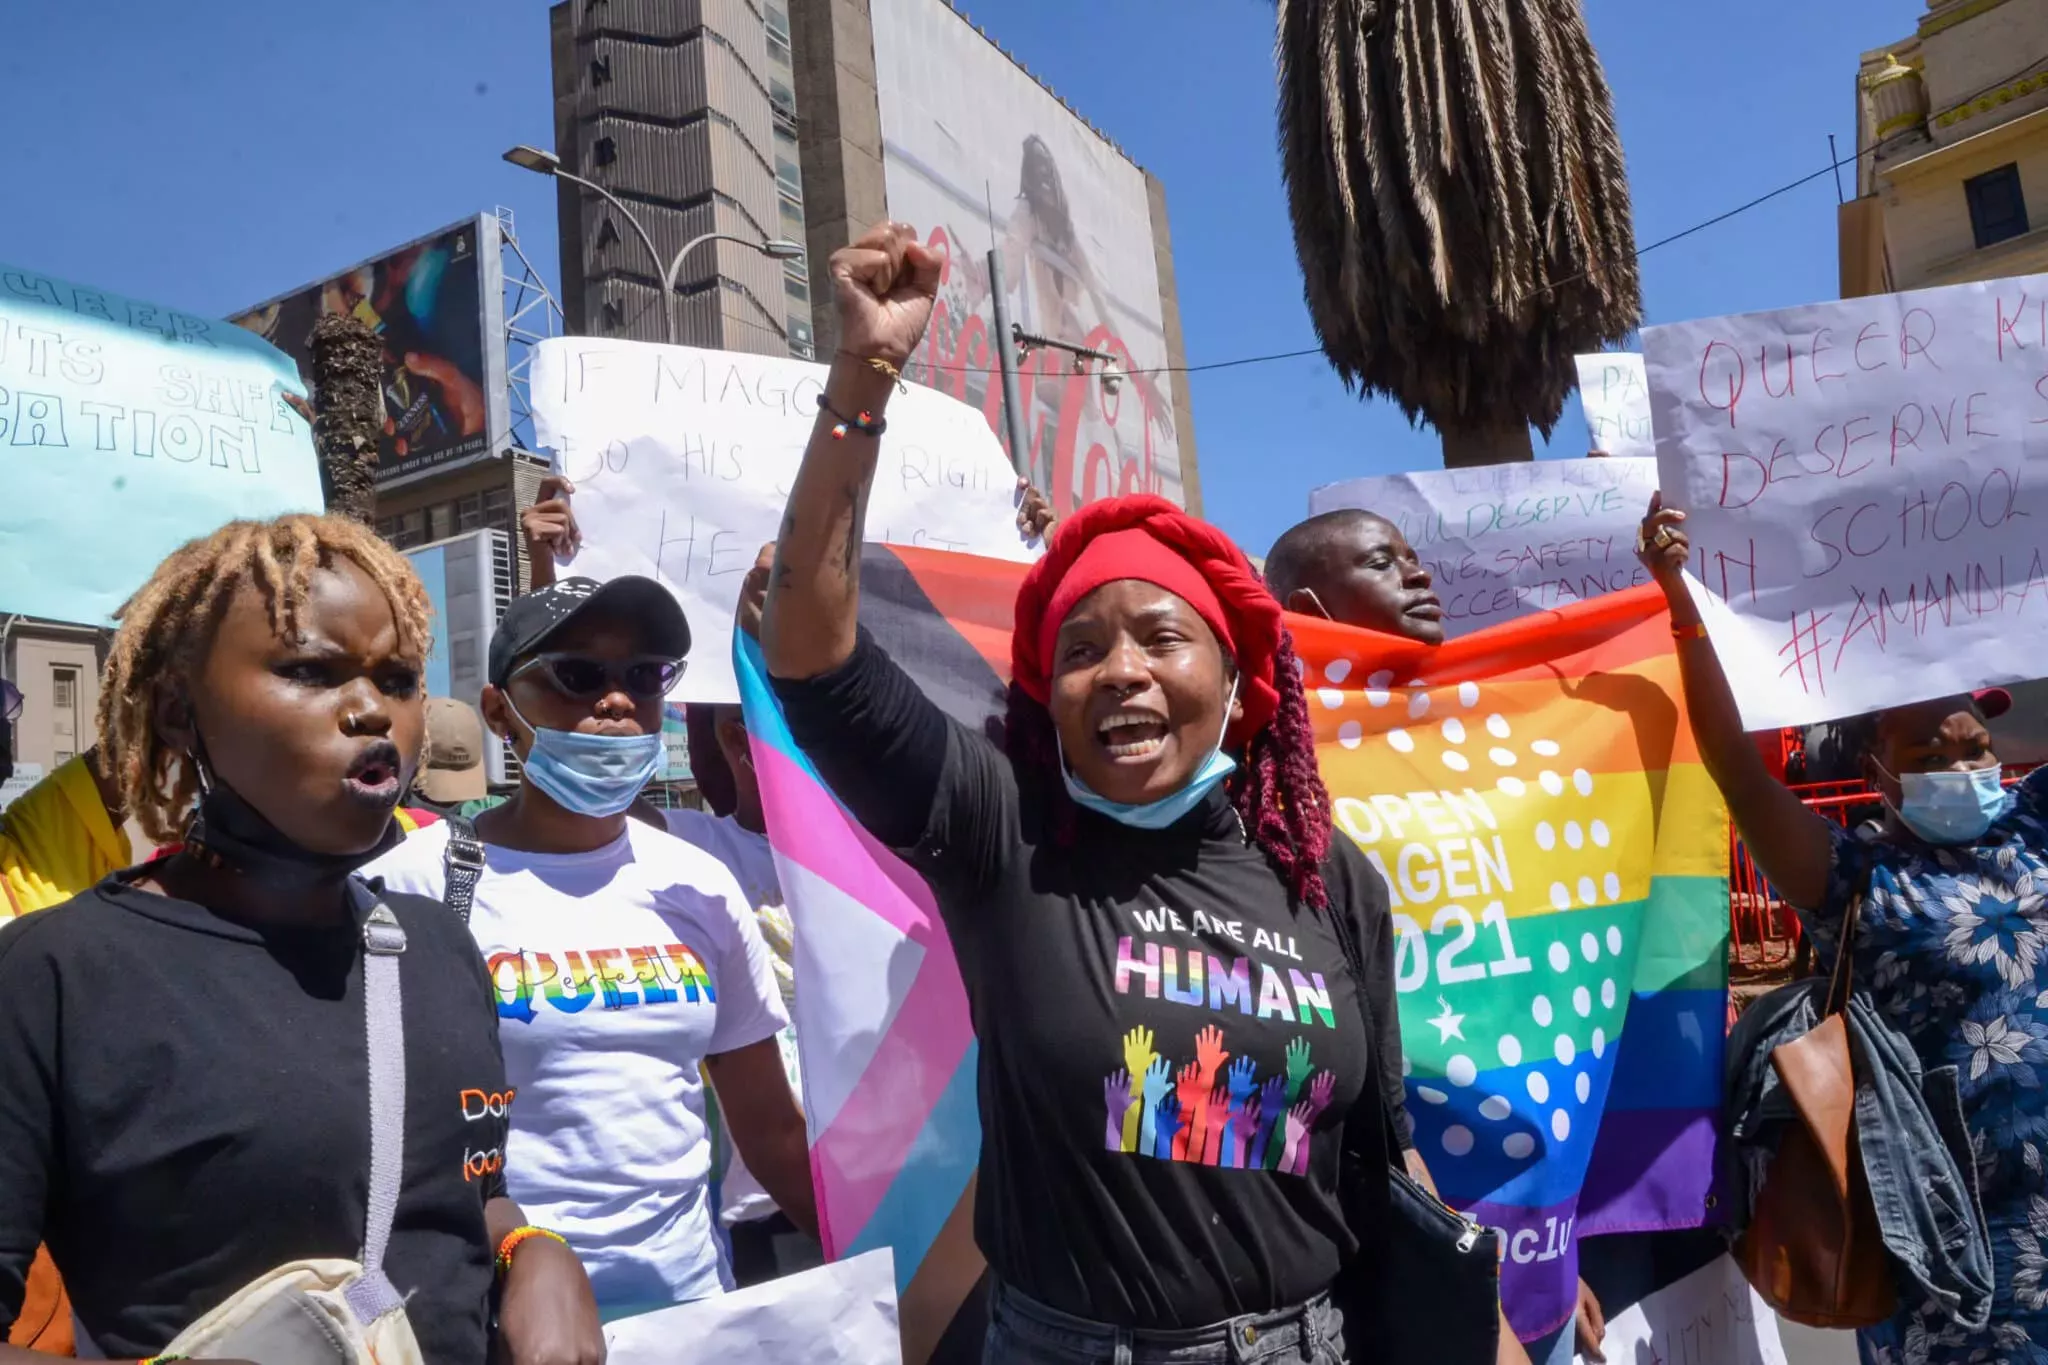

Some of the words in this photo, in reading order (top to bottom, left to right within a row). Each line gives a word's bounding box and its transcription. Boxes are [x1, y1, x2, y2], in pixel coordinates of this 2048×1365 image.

[2, 271, 217, 348] UEER
[0, 318, 104, 385] TS
[563, 348, 617, 405] IF
[653, 354, 827, 417] MAGO
[1603, 366, 1649, 402] PA
[1700, 308, 1942, 428] QUEER
[1996, 294, 2048, 361] KI
[0, 386, 261, 474] ATION
[682, 432, 744, 481] HIS
[899, 444, 989, 492] RIGH
[1719, 393, 1998, 509] DESERVE
[655, 510, 746, 582] HE
[1400, 510, 1457, 546] OU
[1466, 487, 1625, 539] DESERVE
[1699, 539, 1757, 606] IN
[1803, 468, 2030, 579] SCHOOL
[1443, 567, 1645, 621] CCEPTANCE
[1779, 547, 2048, 697] #AMANDLA
[1334, 788, 1497, 844] OPEN
[1367, 835, 1513, 907] AGEN
[1133, 907, 1186, 933] WE
[1192, 910, 1245, 943] ARE
[1253, 928, 1303, 960] ALL
[1393, 901, 1532, 993] 021
[1114, 936, 1336, 1029] HUMAN
